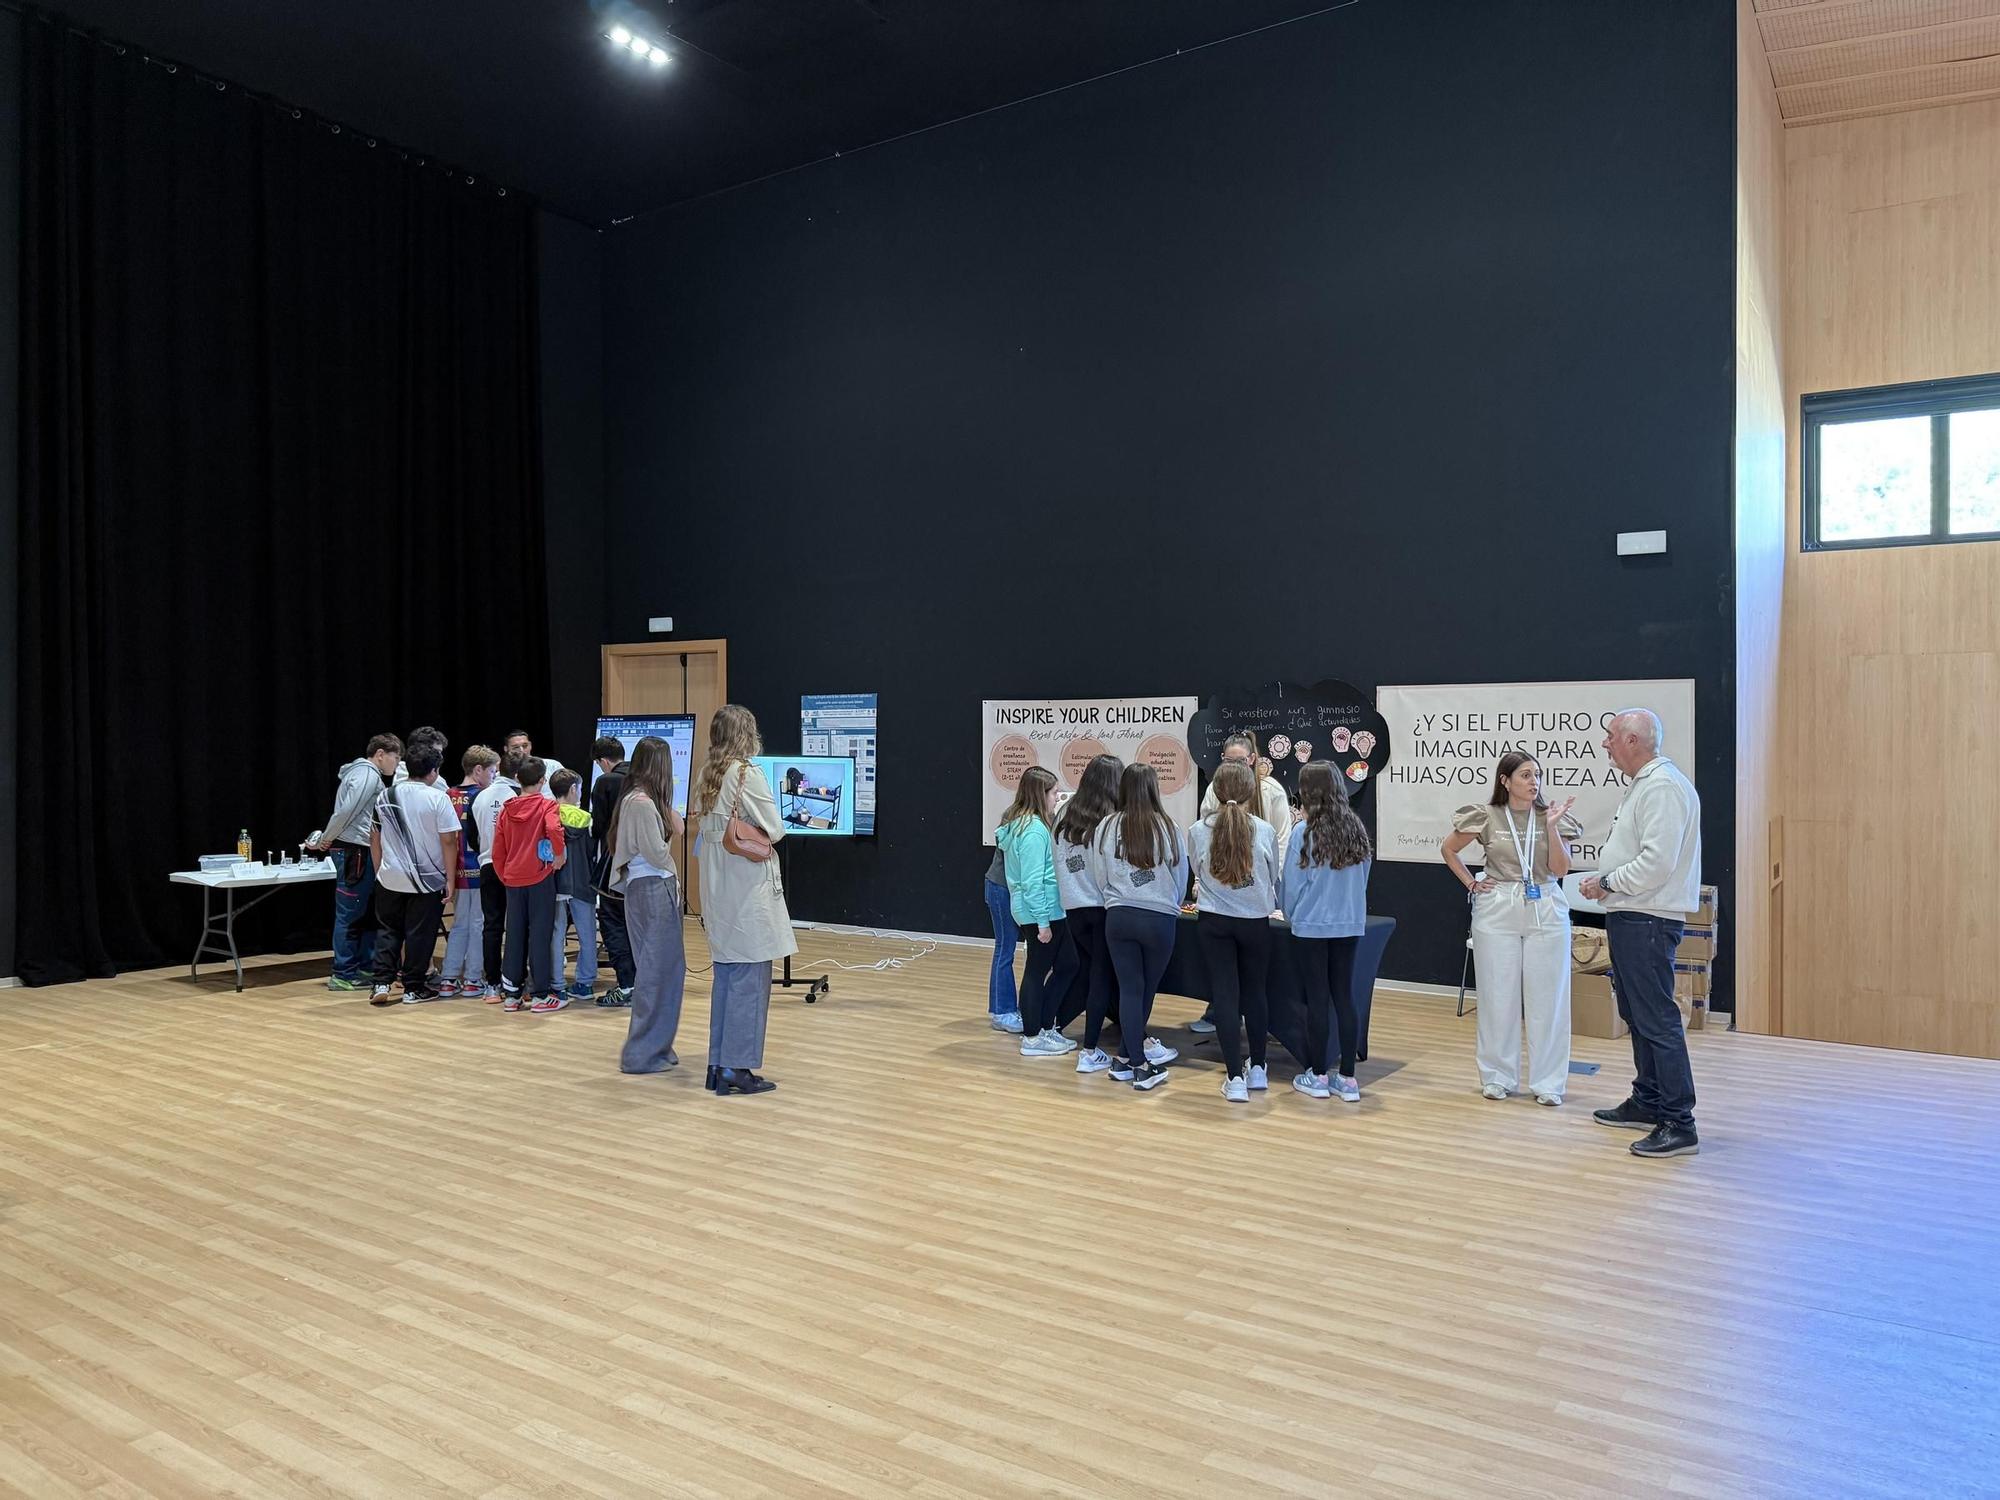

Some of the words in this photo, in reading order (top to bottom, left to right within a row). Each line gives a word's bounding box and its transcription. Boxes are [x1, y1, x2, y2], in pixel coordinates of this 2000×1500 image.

[996, 707, 1055, 725] INSPIRE
[1059, 707, 1100, 724] YOUR
[1105, 705, 1185, 724] CHILDREN
[1413, 713, 1436, 737] ¿Y
[1442, 713, 1459, 732] SI
[1468, 713, 1491, 732] EL
[1498, 712, 1593, 732] FUTURO
[1414, 740, 1528, 759] IMAGINAS
[1536, 740, 1596, 759] PARA
[1390, 765, 1488, 787] HIJAS/OS
[1545, 767, 1596, 787] IEZA
